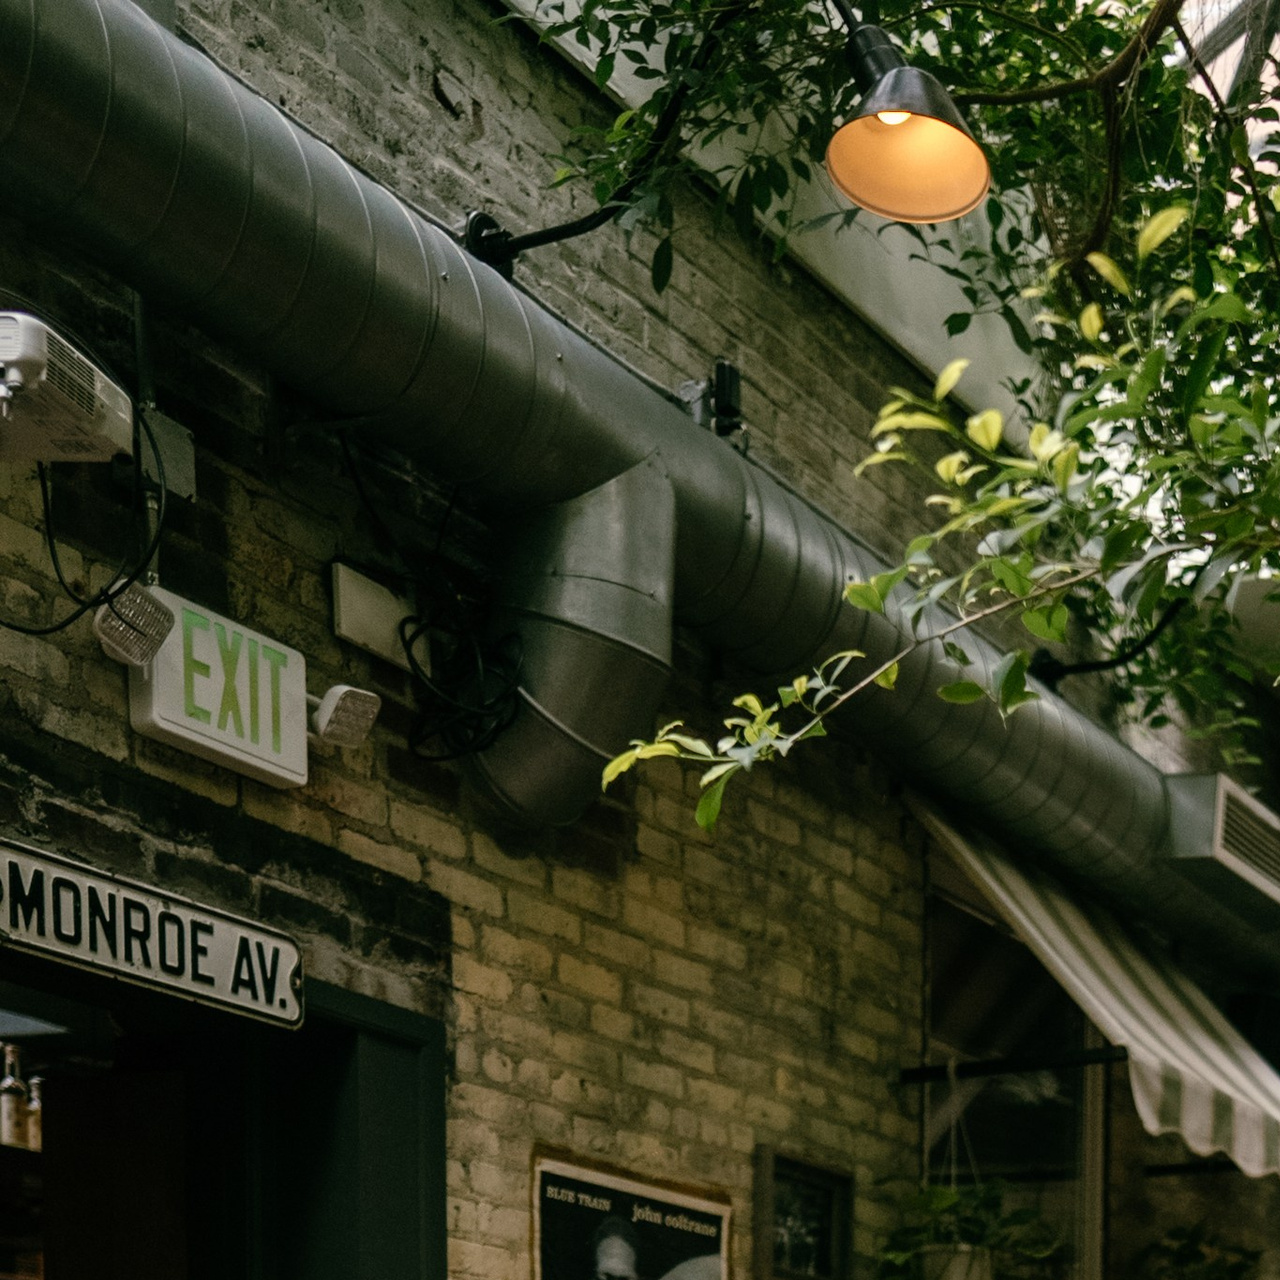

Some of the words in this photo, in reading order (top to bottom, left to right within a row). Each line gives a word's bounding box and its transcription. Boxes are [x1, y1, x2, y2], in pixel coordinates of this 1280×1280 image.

[182, 607, 288, 754] EXIT
[8, 860, 215, 988] MONROE
[231, 935, 287, 1010] AV.
[546, 1185, 576, 1202] BLUE
[577, 1192, 612, 1212] TRAIN
[631, 1203, 663, 1225] john
[664, 1215, 718, 1238] coltrane
